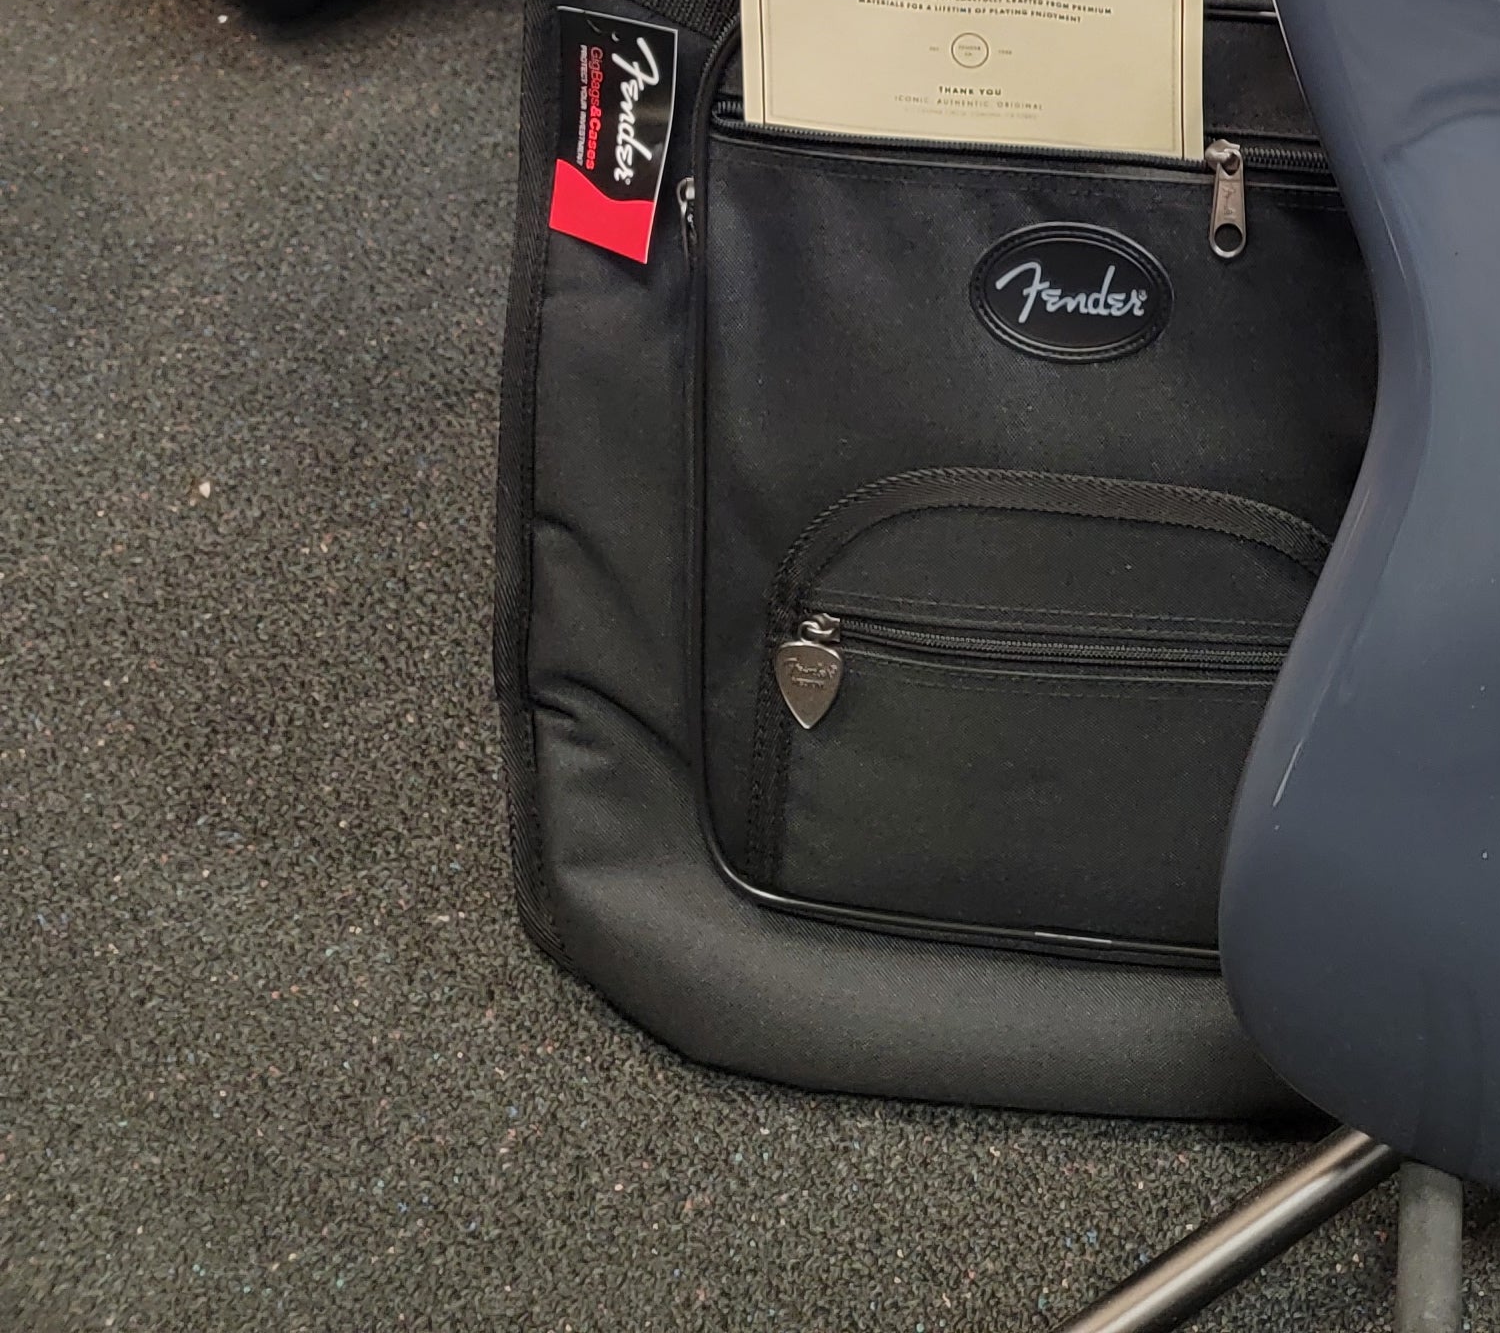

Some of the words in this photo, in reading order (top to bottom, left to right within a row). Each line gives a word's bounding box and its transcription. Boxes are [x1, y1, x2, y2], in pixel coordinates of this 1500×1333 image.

[907, 2, 923, 10] FOR
[1046, 0, 1069, 9] FROM
[1072, 4, 1112, 14] PREMIUM
[939, 86, 974, 95] THANK
[979, 88, 1001, 96] YOU
[611, 36, 660, 185] Fender
[995, 261, 1148, 323] Fender
